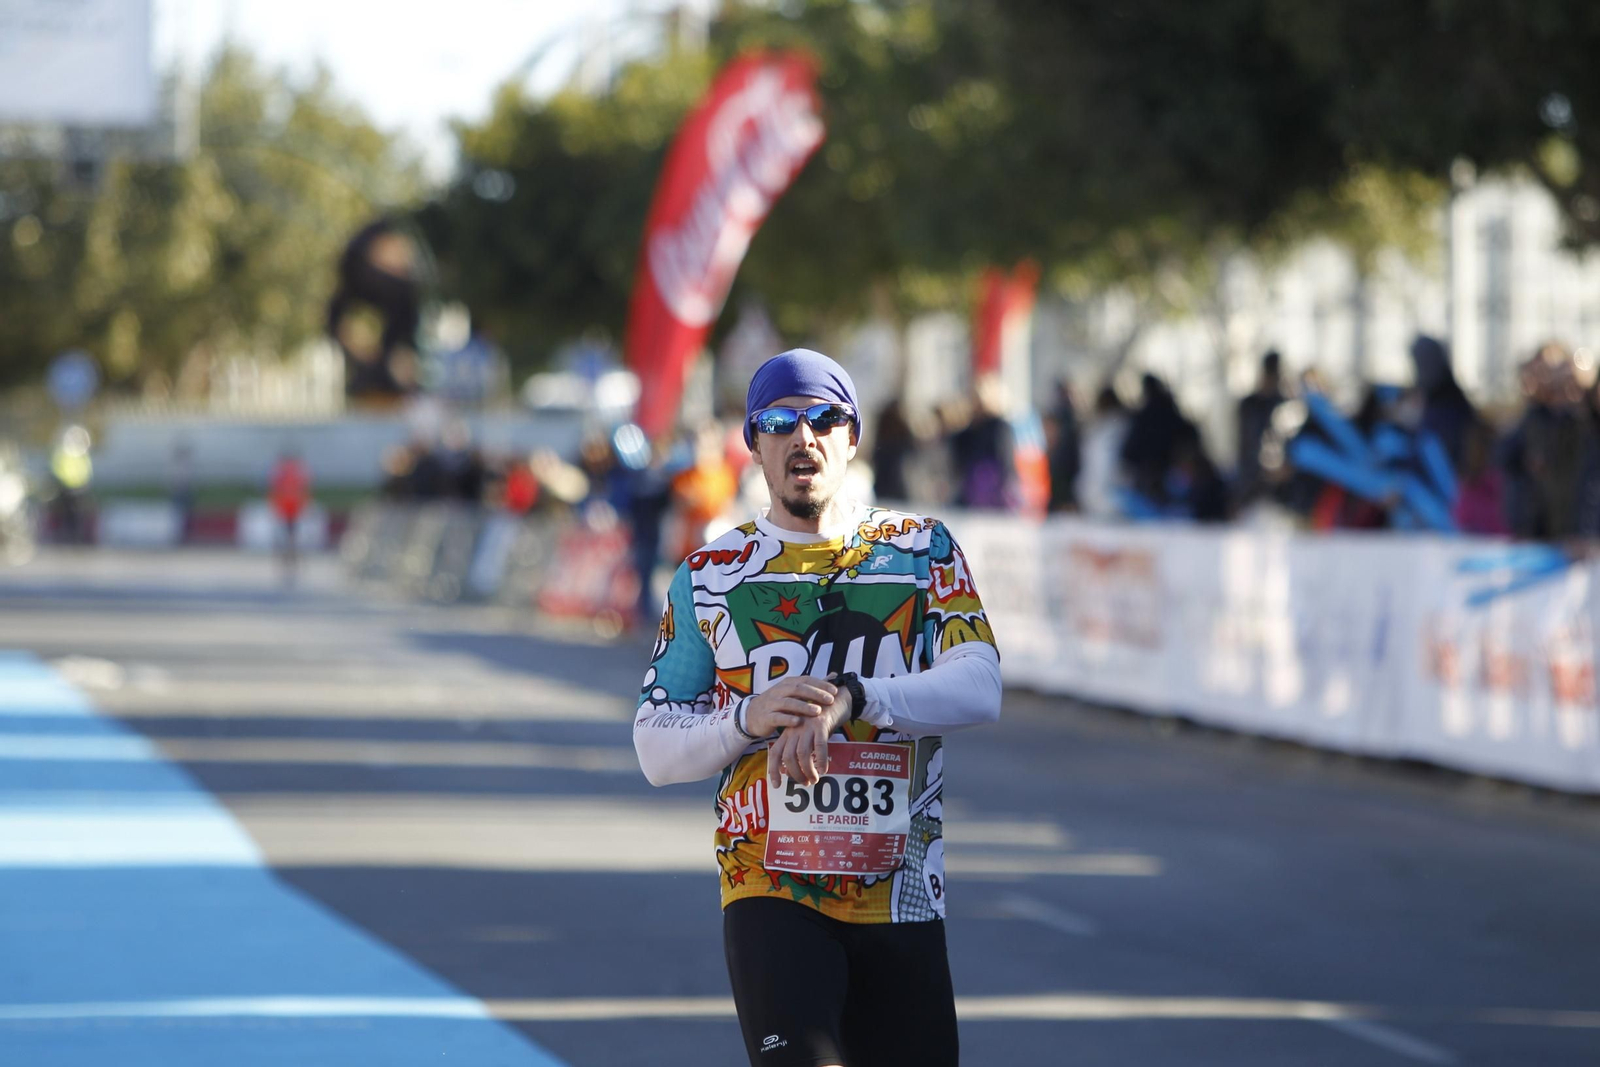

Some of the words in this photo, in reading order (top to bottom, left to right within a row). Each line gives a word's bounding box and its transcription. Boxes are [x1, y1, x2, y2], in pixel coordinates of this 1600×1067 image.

[860, 751, 901, 762] CARRERA
[848, 761, 902, 773] SALUDABLE
[784, 775, 895, 816] 5083
[809, 814, 823, 824] LE
[827, 814, 870, 826] PARDIÉ
